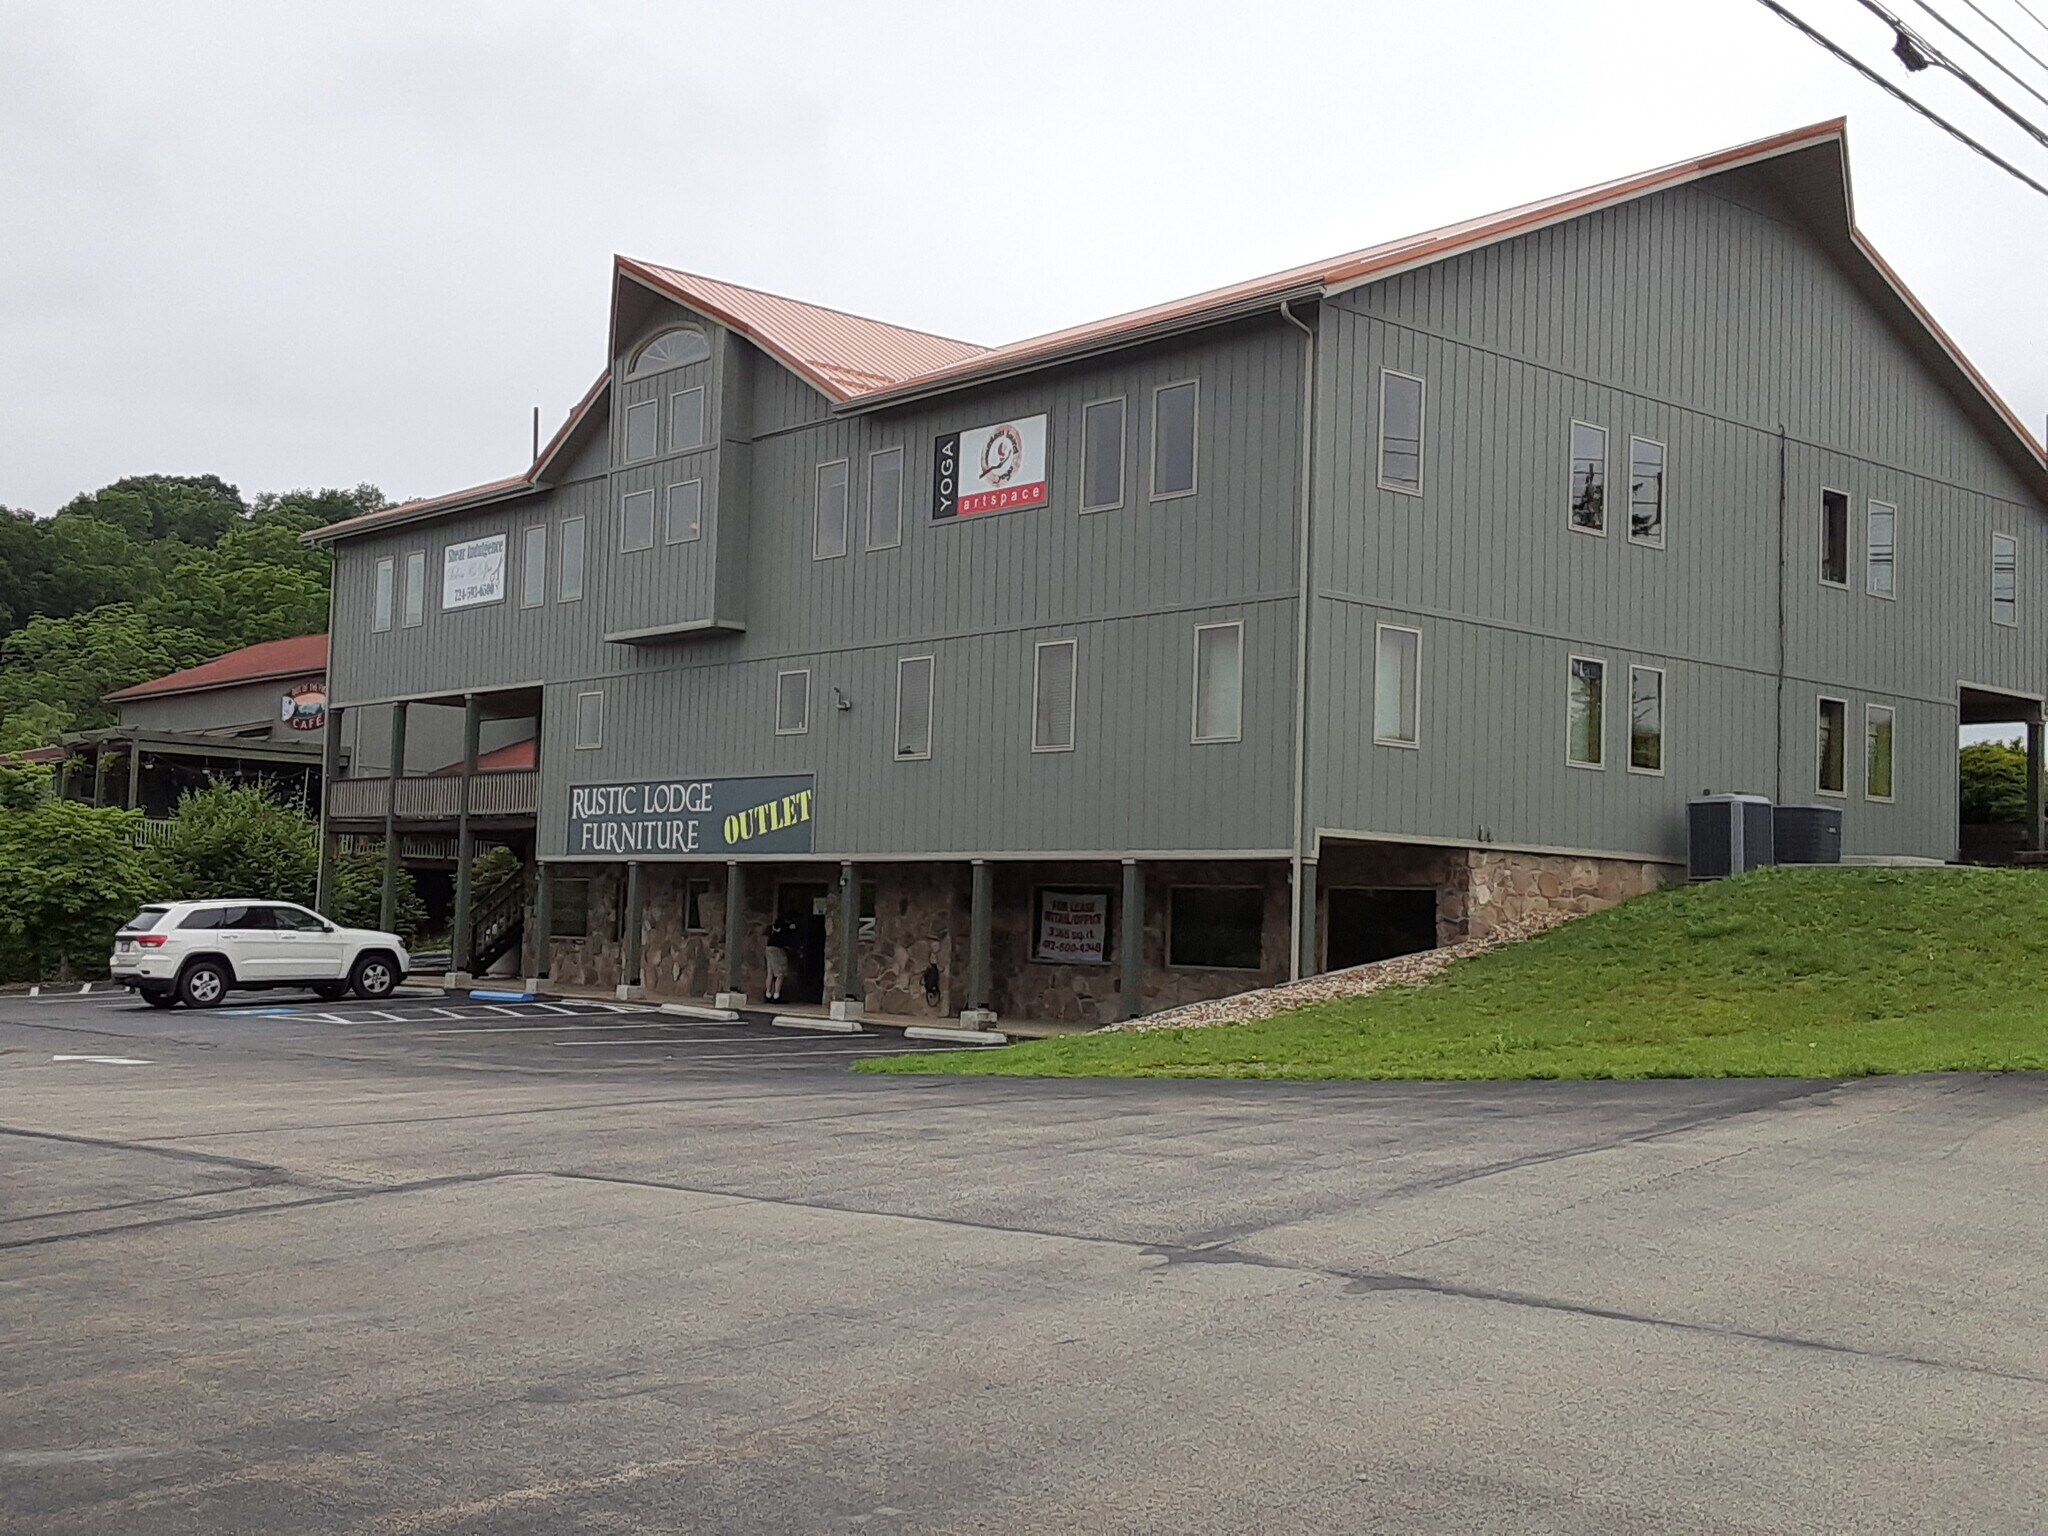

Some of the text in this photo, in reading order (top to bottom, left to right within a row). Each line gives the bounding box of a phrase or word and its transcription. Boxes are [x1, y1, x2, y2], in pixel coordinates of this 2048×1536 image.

[940, 440, 954, 512] YOGA
[963, 486, 1040, 511] artspace
[467, 540, 504, 560] Indulgence
[292, 713, 324, 729] CAFÉ
[572, 783, 713, 819] RUSTIC LODGE
[723, 789, 812, 844] OUTLET
[581, 820, 699, 853] FURNITURE
